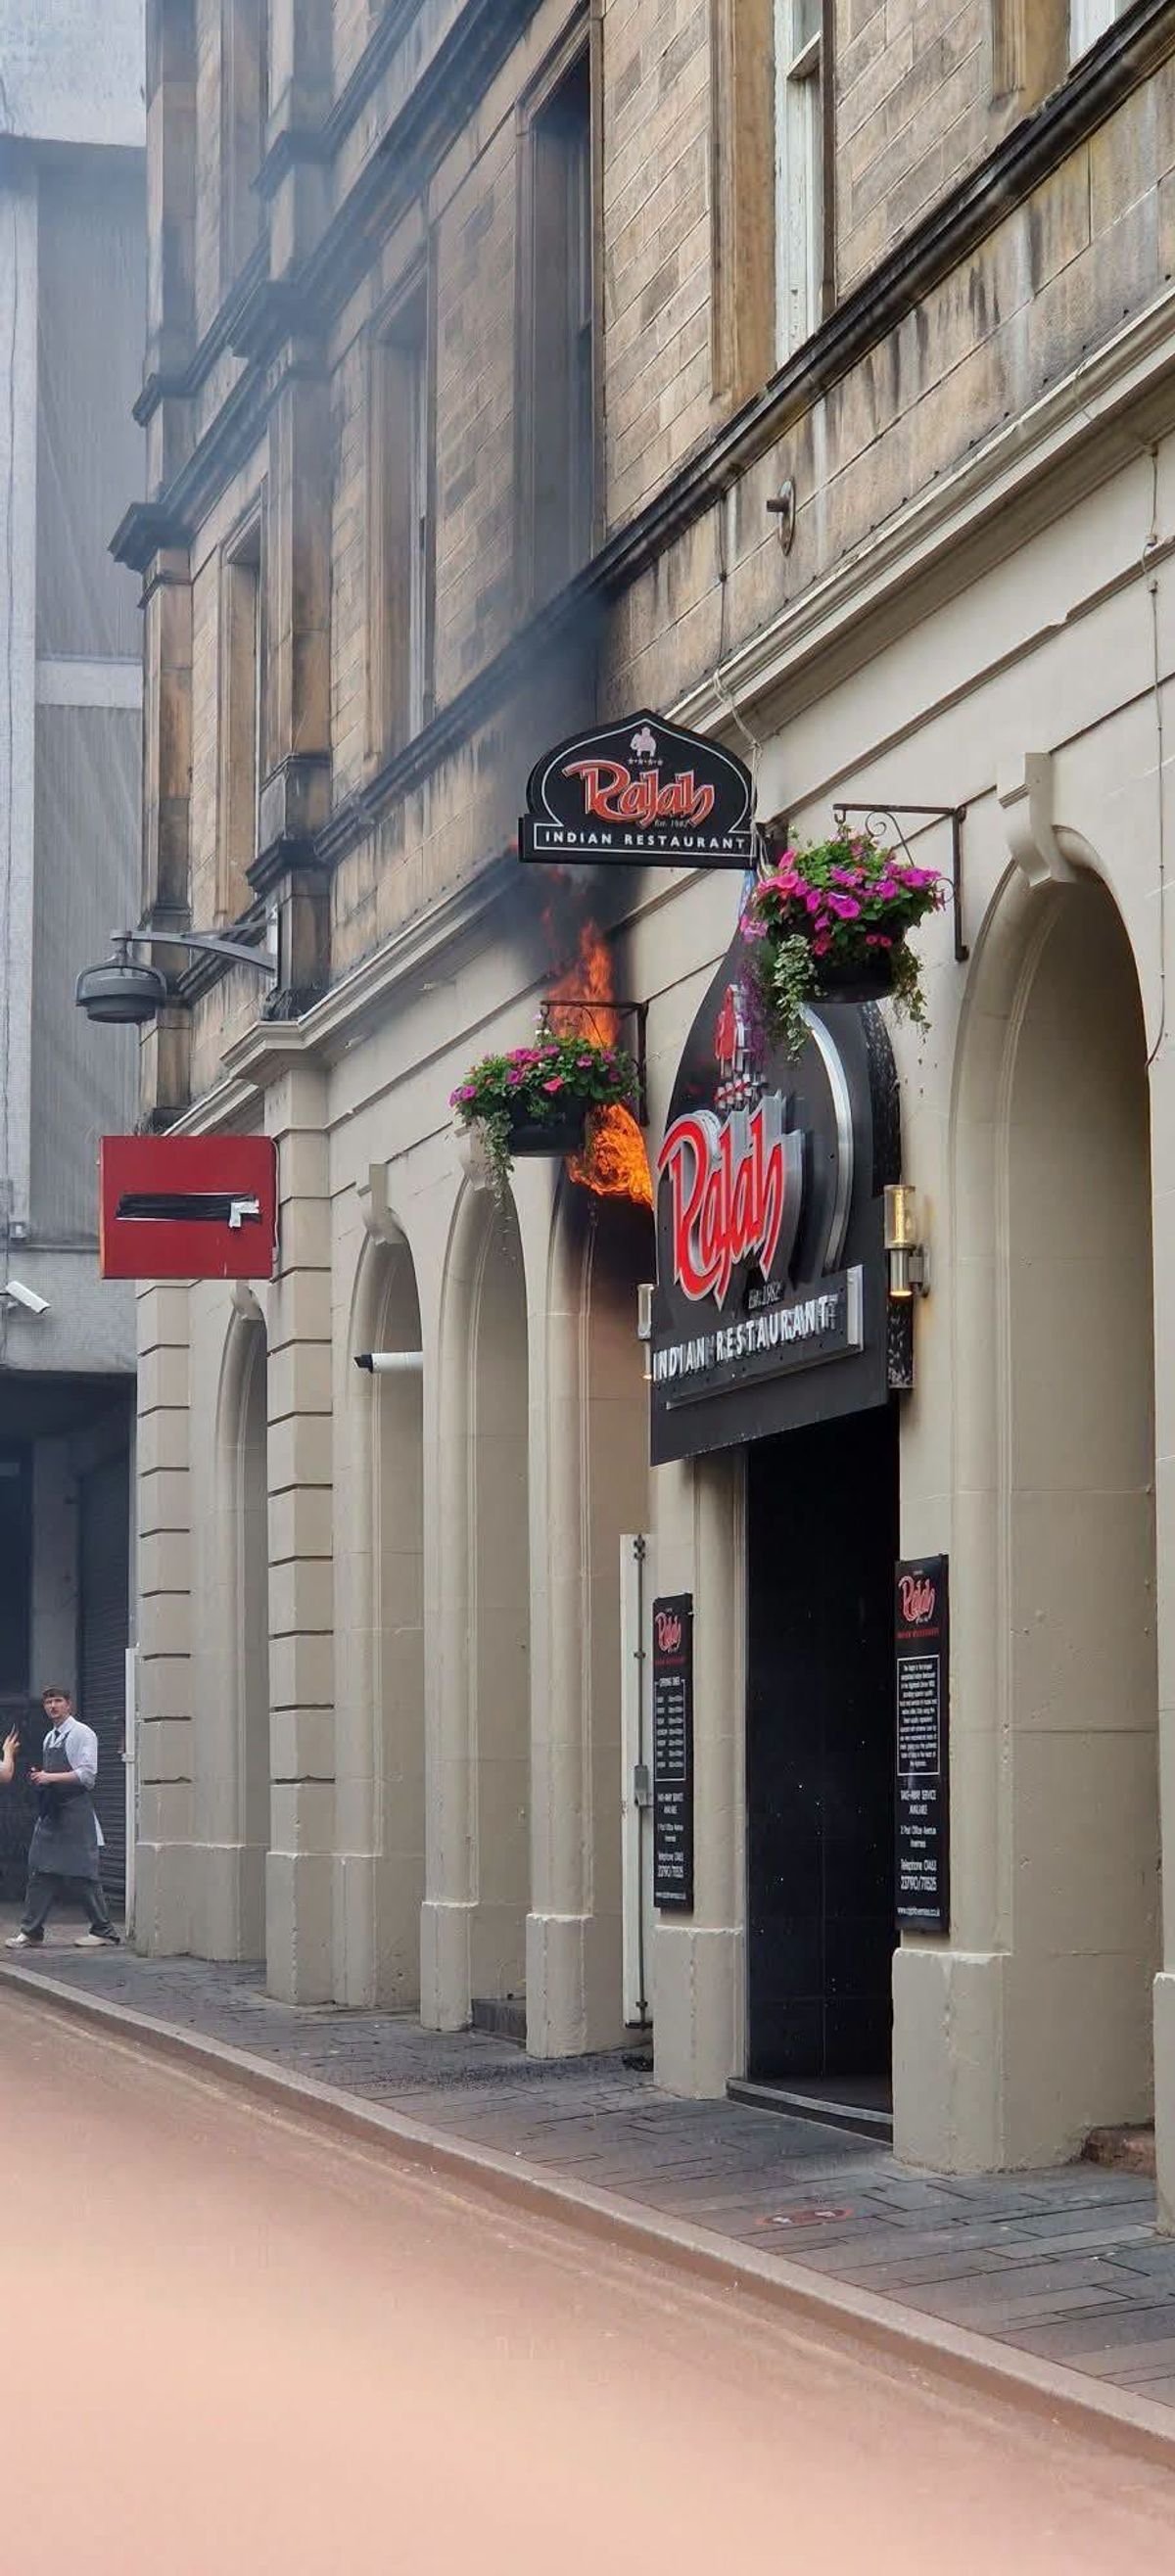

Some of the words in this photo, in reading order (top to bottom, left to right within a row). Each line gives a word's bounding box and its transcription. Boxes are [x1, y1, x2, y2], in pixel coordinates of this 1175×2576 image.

[561, 759, 716, 829] Rajah
[545, 831, 612, 845] INDIAN
[625, 833, 745, 850] RESTAURANT
[658, 1090, 801, 1312] Rajah
[653, 1337, 709, 1382] INDIAN
[717, 1294, 837, 1364] RESTAURANT
